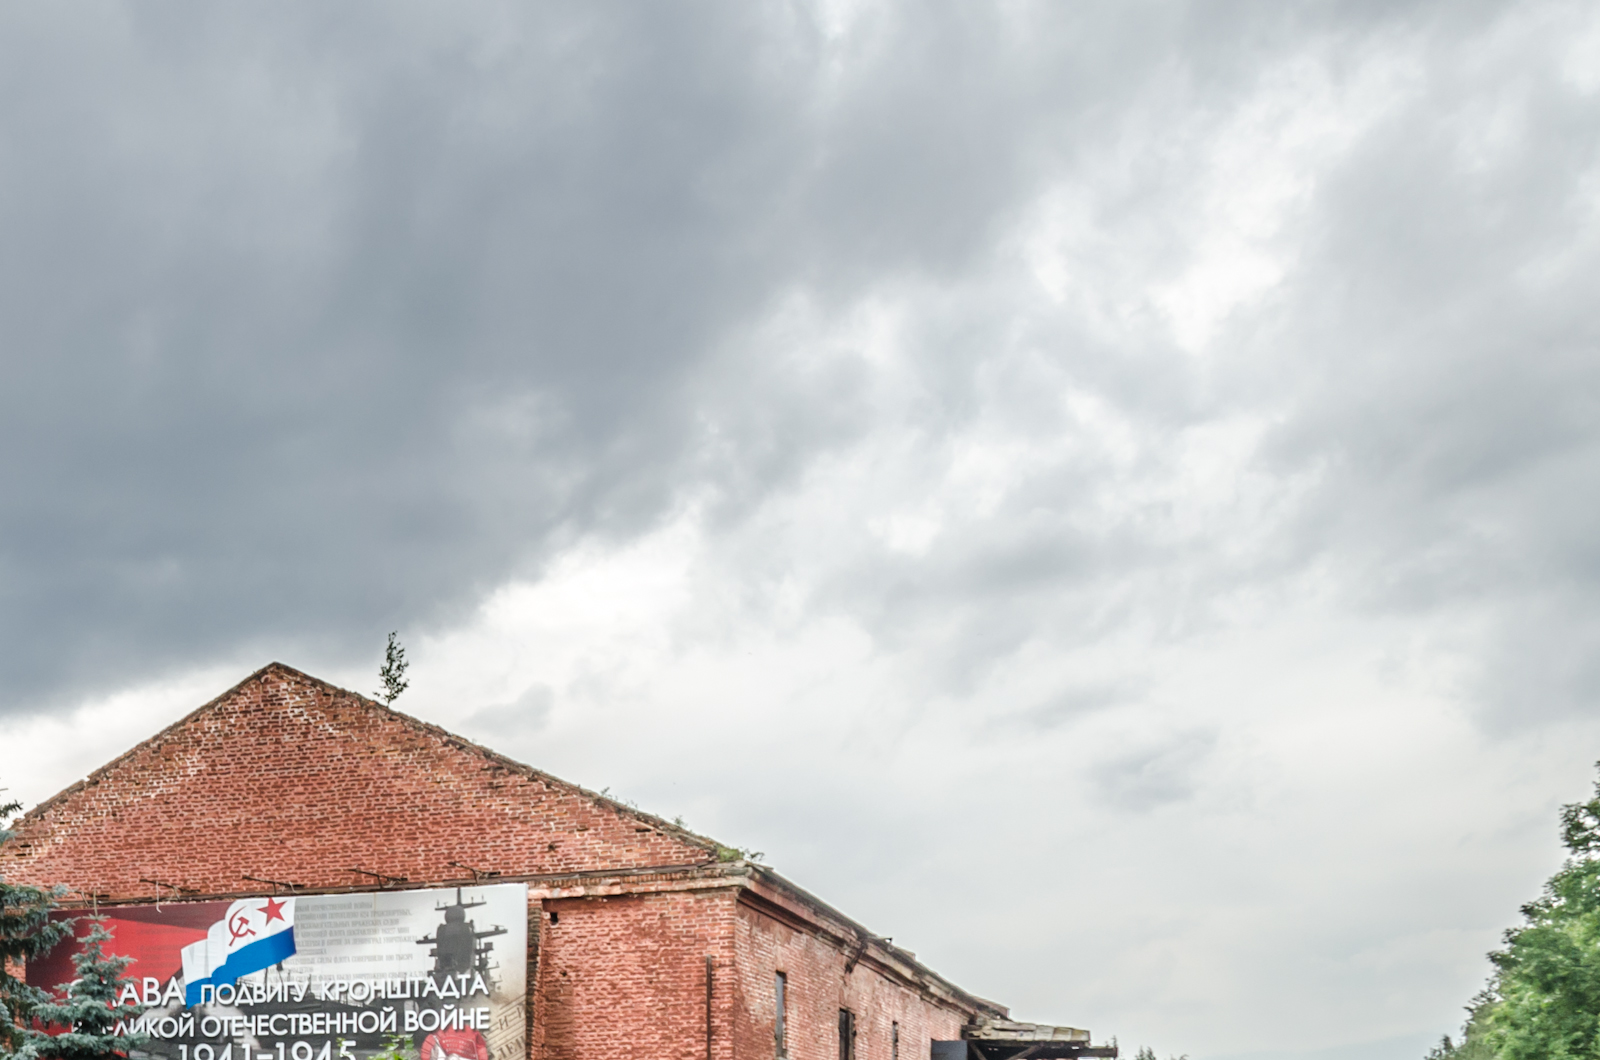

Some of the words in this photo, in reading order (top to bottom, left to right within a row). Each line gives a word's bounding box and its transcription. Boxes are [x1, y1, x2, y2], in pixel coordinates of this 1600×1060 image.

[67, 976, 186, 1007] АВА
[200, 981, 309, 1006] ПОДВИГУ
[321, 972, 489, 1001] КРОНШТАДТА
[95, 1012, 194, 1038] ЛИКОЙ
[200, 1006, 396, 1038] ОТЕЧЕСТВЕННОЙ
[404, 1004, 490, 1032] ВОЙНЕ
